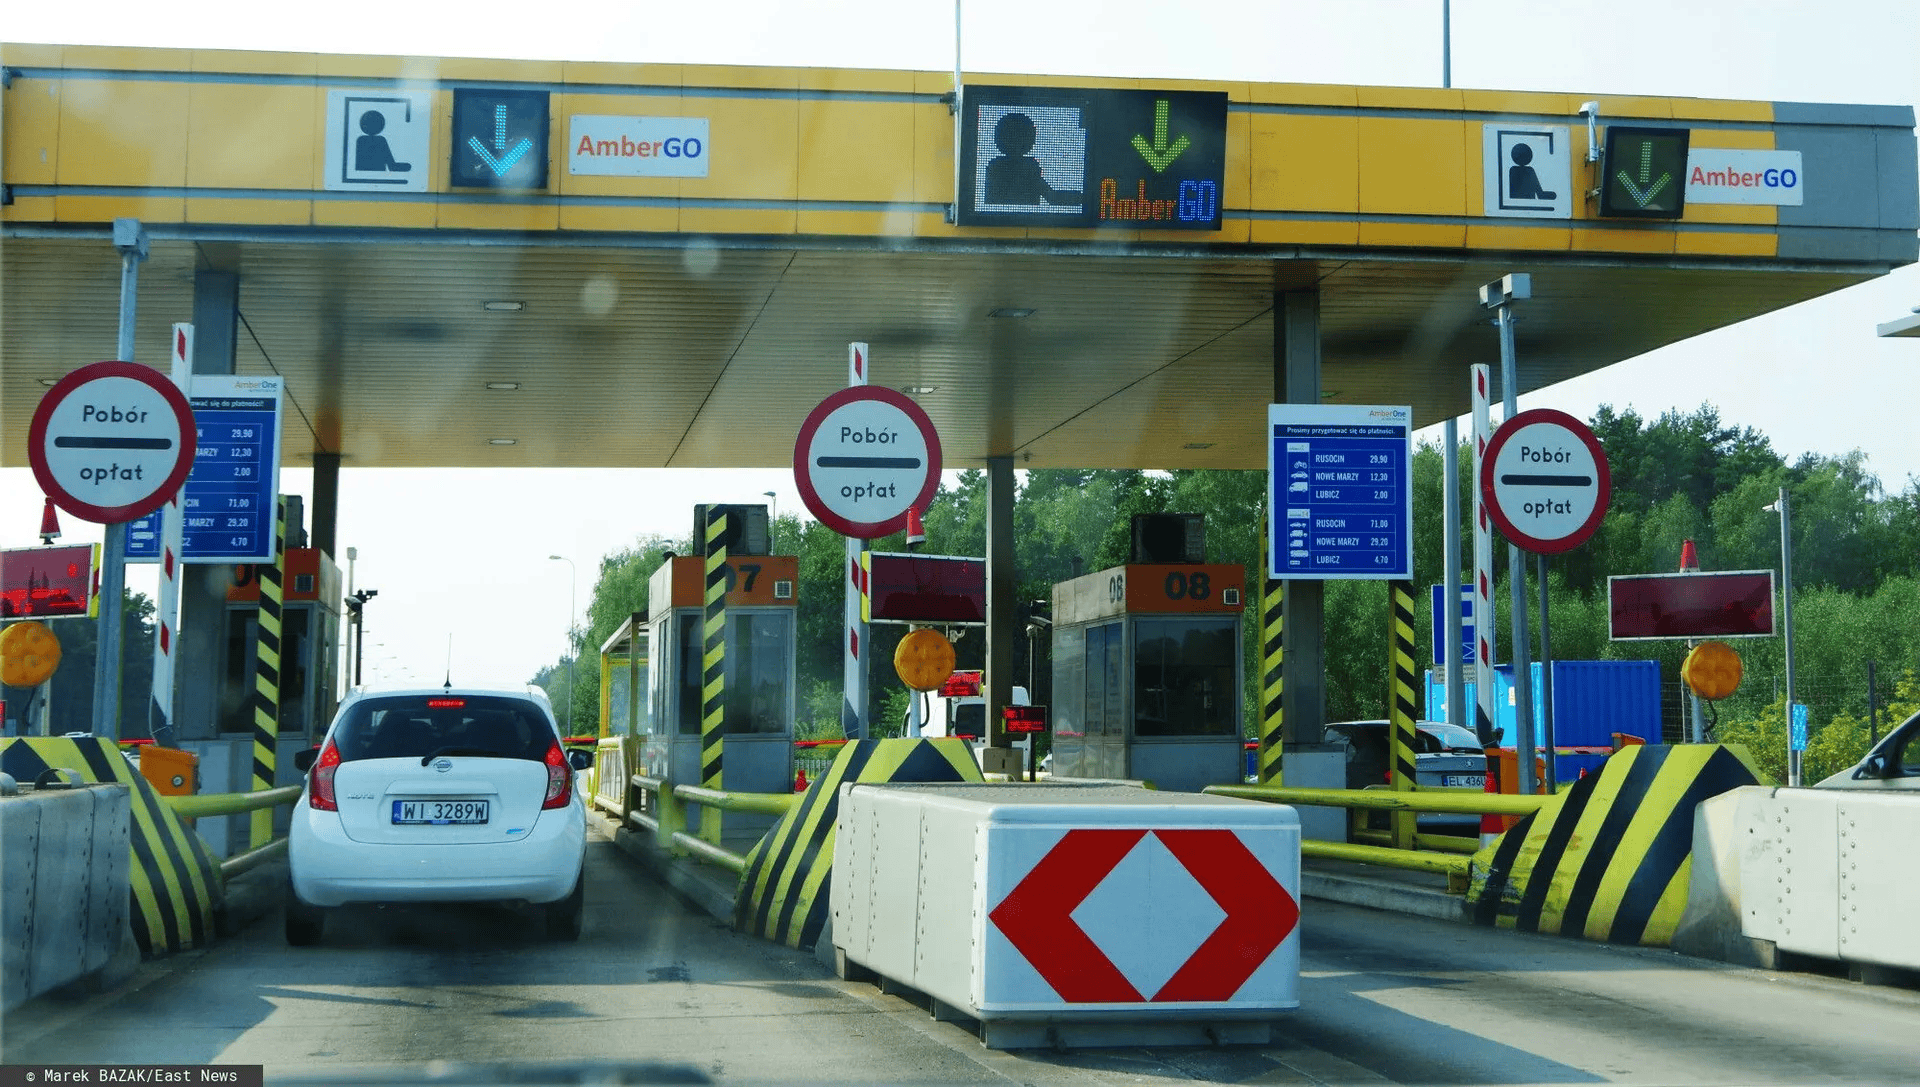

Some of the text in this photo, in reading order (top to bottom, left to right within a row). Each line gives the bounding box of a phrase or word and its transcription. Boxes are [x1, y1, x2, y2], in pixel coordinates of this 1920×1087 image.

[576, 134, 702, 159] AmberGO
[1690, 165, 1798, 189] AmberGO
[1099, 178, 1216, 222] AmberGO
[82, 404, 148, 424] Pobór
[840, 426, 898, 445] Pobór
[1315, 454, 1345, 463] RUSOCIN
[1521, 445, 1572, 464] Pobór
[79, 462, 143, 486] opłat
[1315, 472, 1336, 481] NOWE
[1336, 472, 1360, 481] MARZY
[840, 481, 897, 502] opłat
[1315, 490, 1340, 499] LUBICZ
[1522, 498, 1572, 517] opłat
[188, 518, 215, 528] MARZY
[1316, 519, 1346, 528] RUSOCIN
[1316, 537, 1336, 546] NOWE
[1337, 537, 1360, 546] MARZY
[1316, 555, 1340, 564] LUBICZ
[1109, 574, 1124, 604] 08
[1164, 571, 1211, 601] 08
[1448, 776, 1463, 787] EL
[404, 803, 424, 820] WI
[434, 803, 485, 820] 3289W
